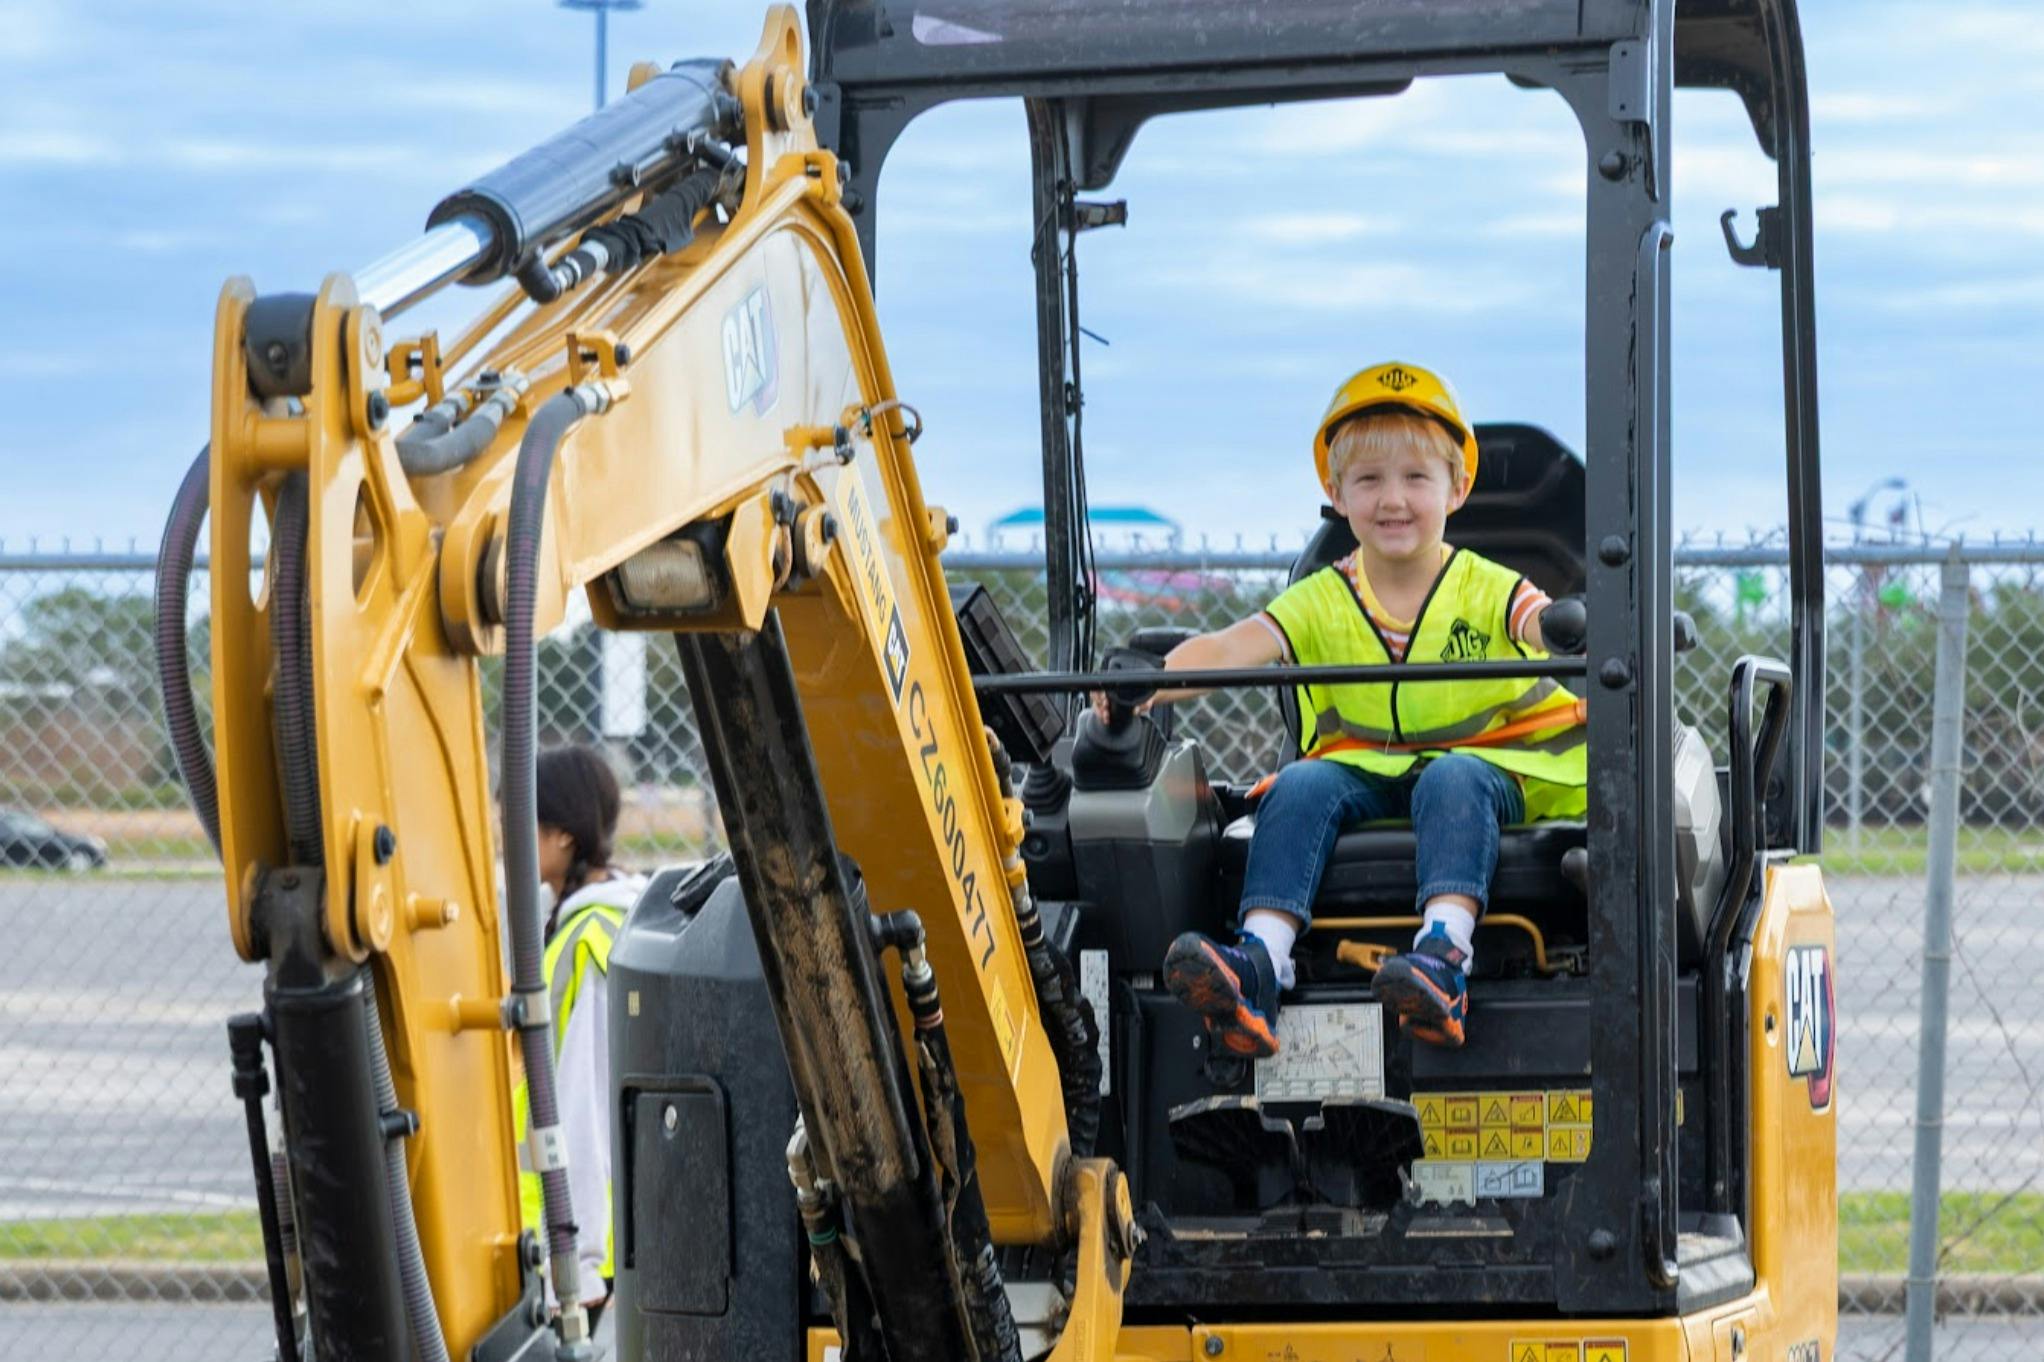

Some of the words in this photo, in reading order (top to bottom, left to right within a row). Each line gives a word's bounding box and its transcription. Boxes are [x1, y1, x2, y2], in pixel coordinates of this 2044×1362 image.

[722, 285, 767, 413] CAT
[847, 486, 887, 625] MUSTANG
[887, 620, 906, 683] CAT
[1448, 627, 1482, 658] DIG
[909, 680, 996, 970] CZ600477
[1786, 948, 1824, 1075] CAT
